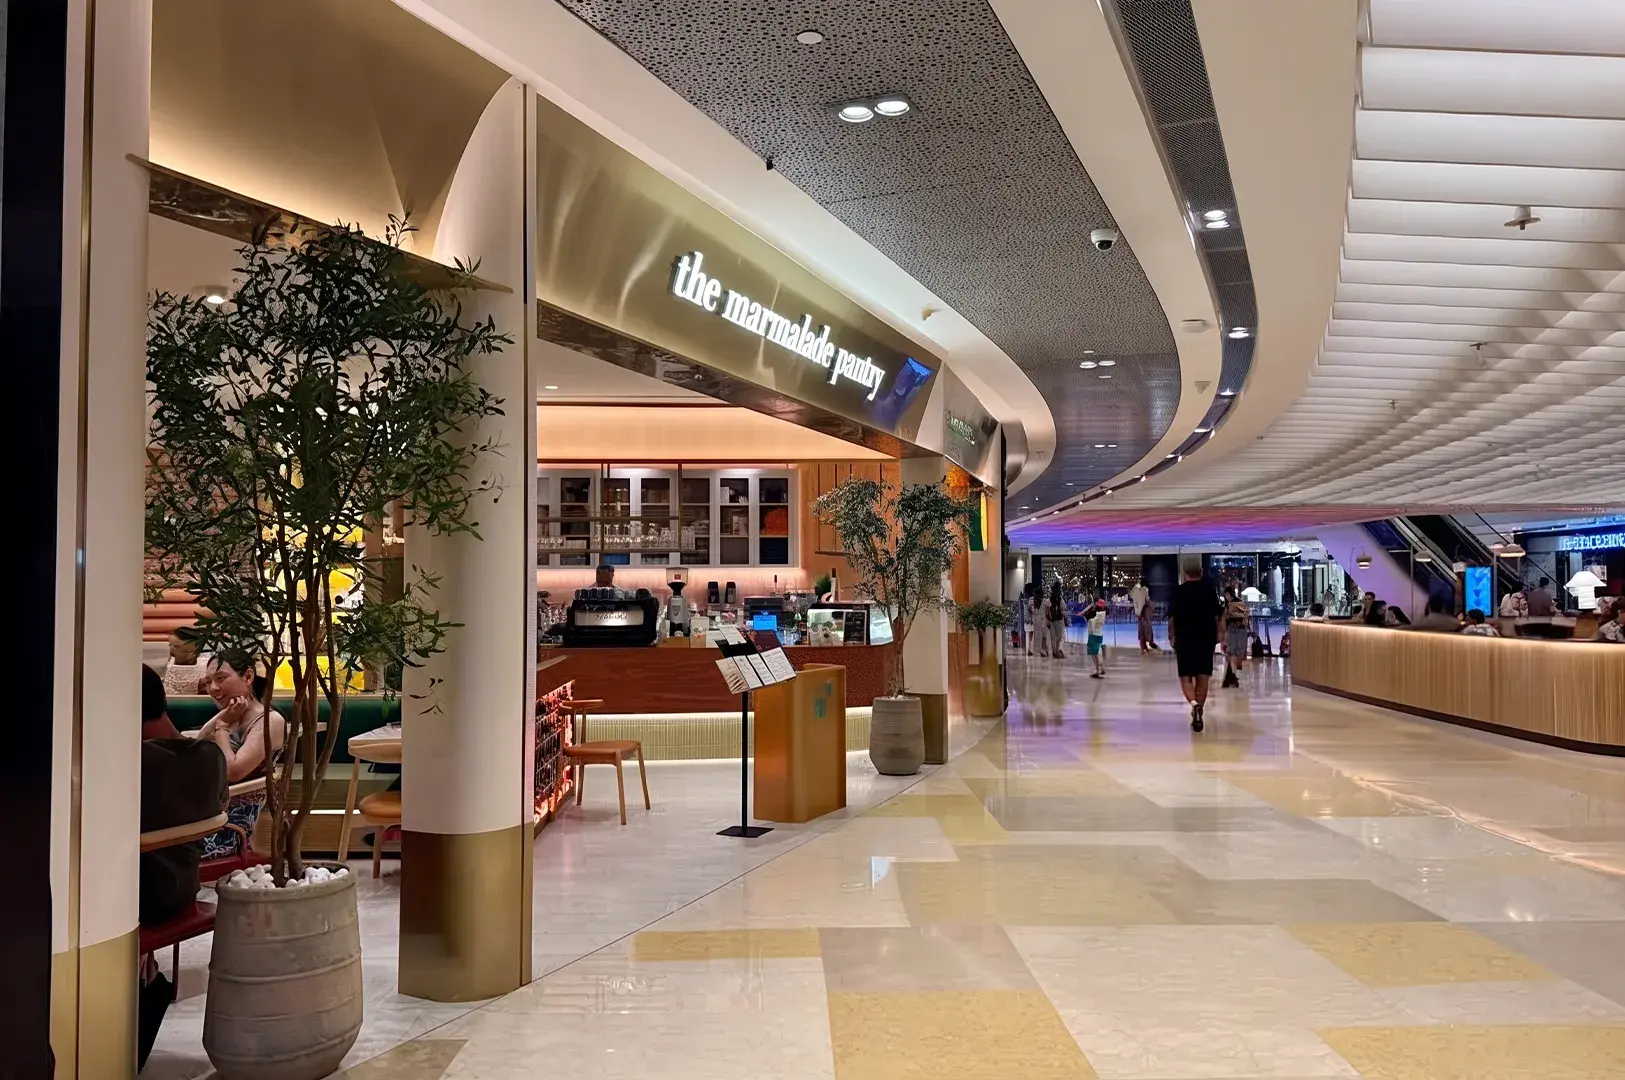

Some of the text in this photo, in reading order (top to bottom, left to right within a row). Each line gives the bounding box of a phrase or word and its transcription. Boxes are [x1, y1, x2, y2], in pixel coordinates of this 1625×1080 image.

[671, 251, 886, 402] the marmalade pantry
